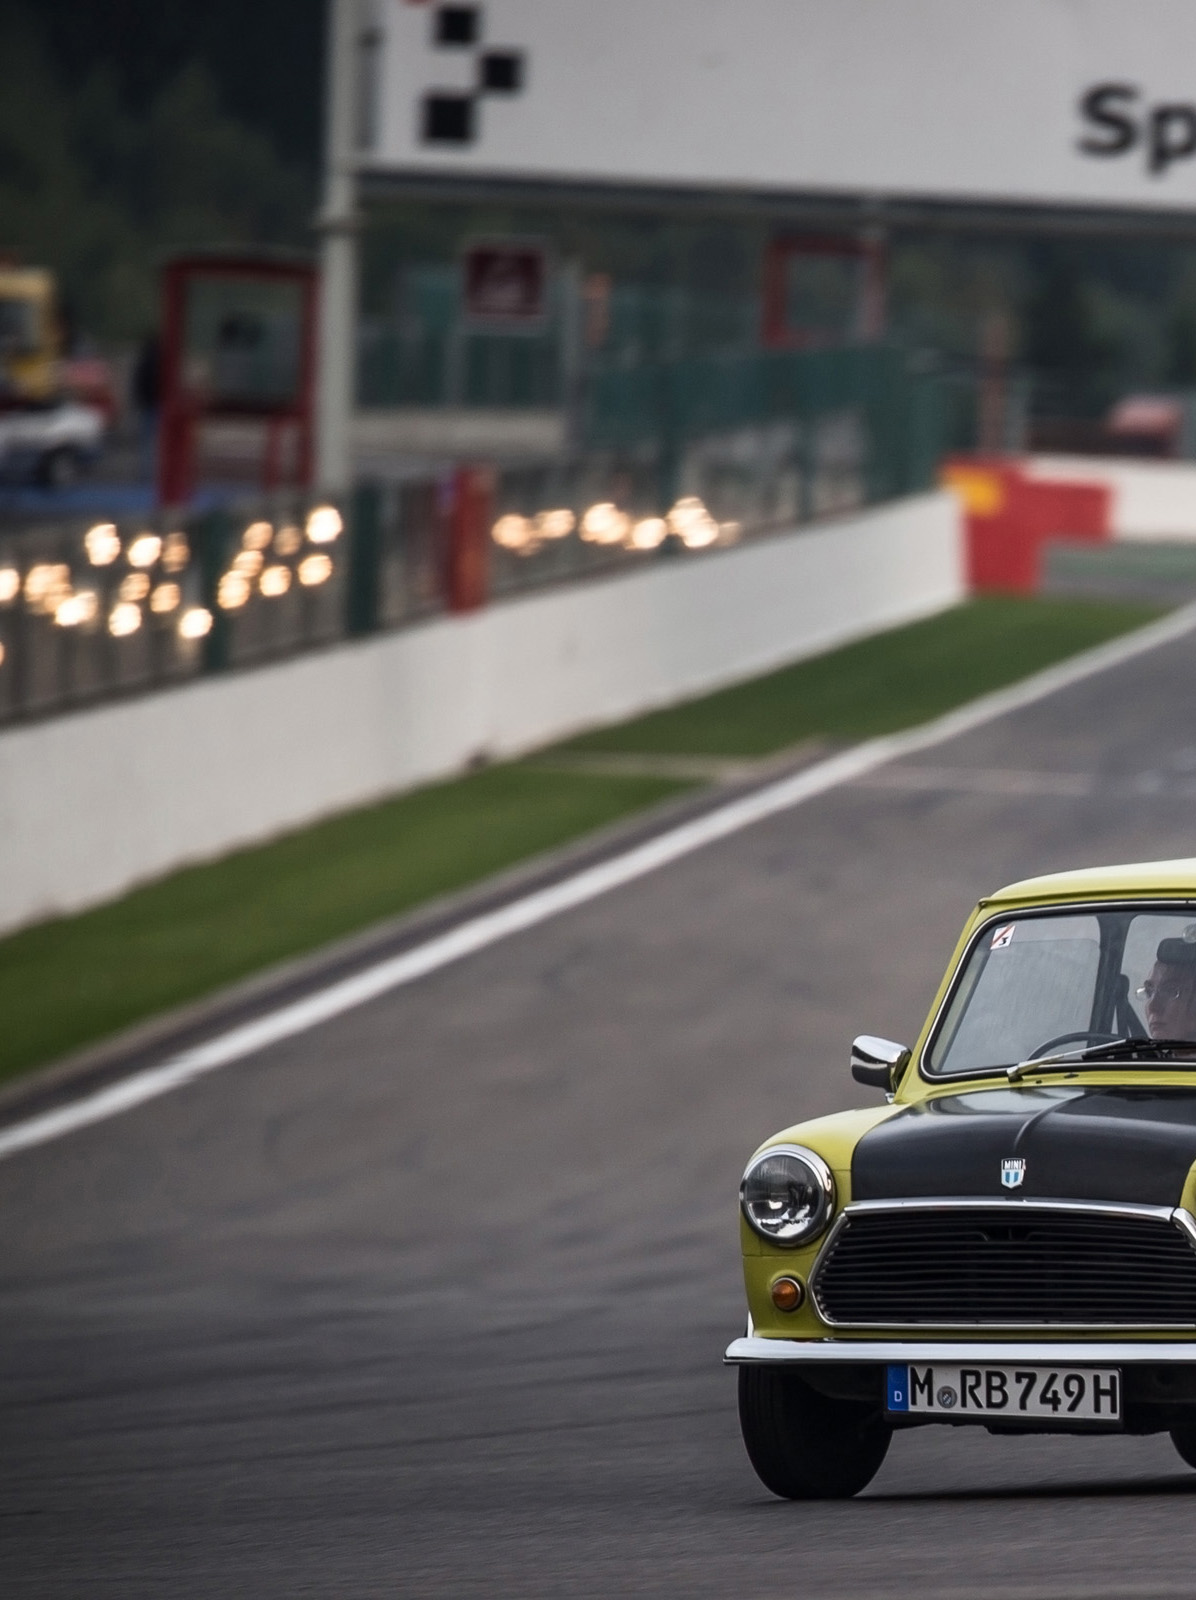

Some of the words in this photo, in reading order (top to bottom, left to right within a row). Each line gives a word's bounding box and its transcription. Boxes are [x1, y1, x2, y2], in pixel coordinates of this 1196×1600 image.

[1004, 1160, 1022, 1169] MINI
[910, 1367, 934, 1407] M
[894, 1390, 902, 1402] D
